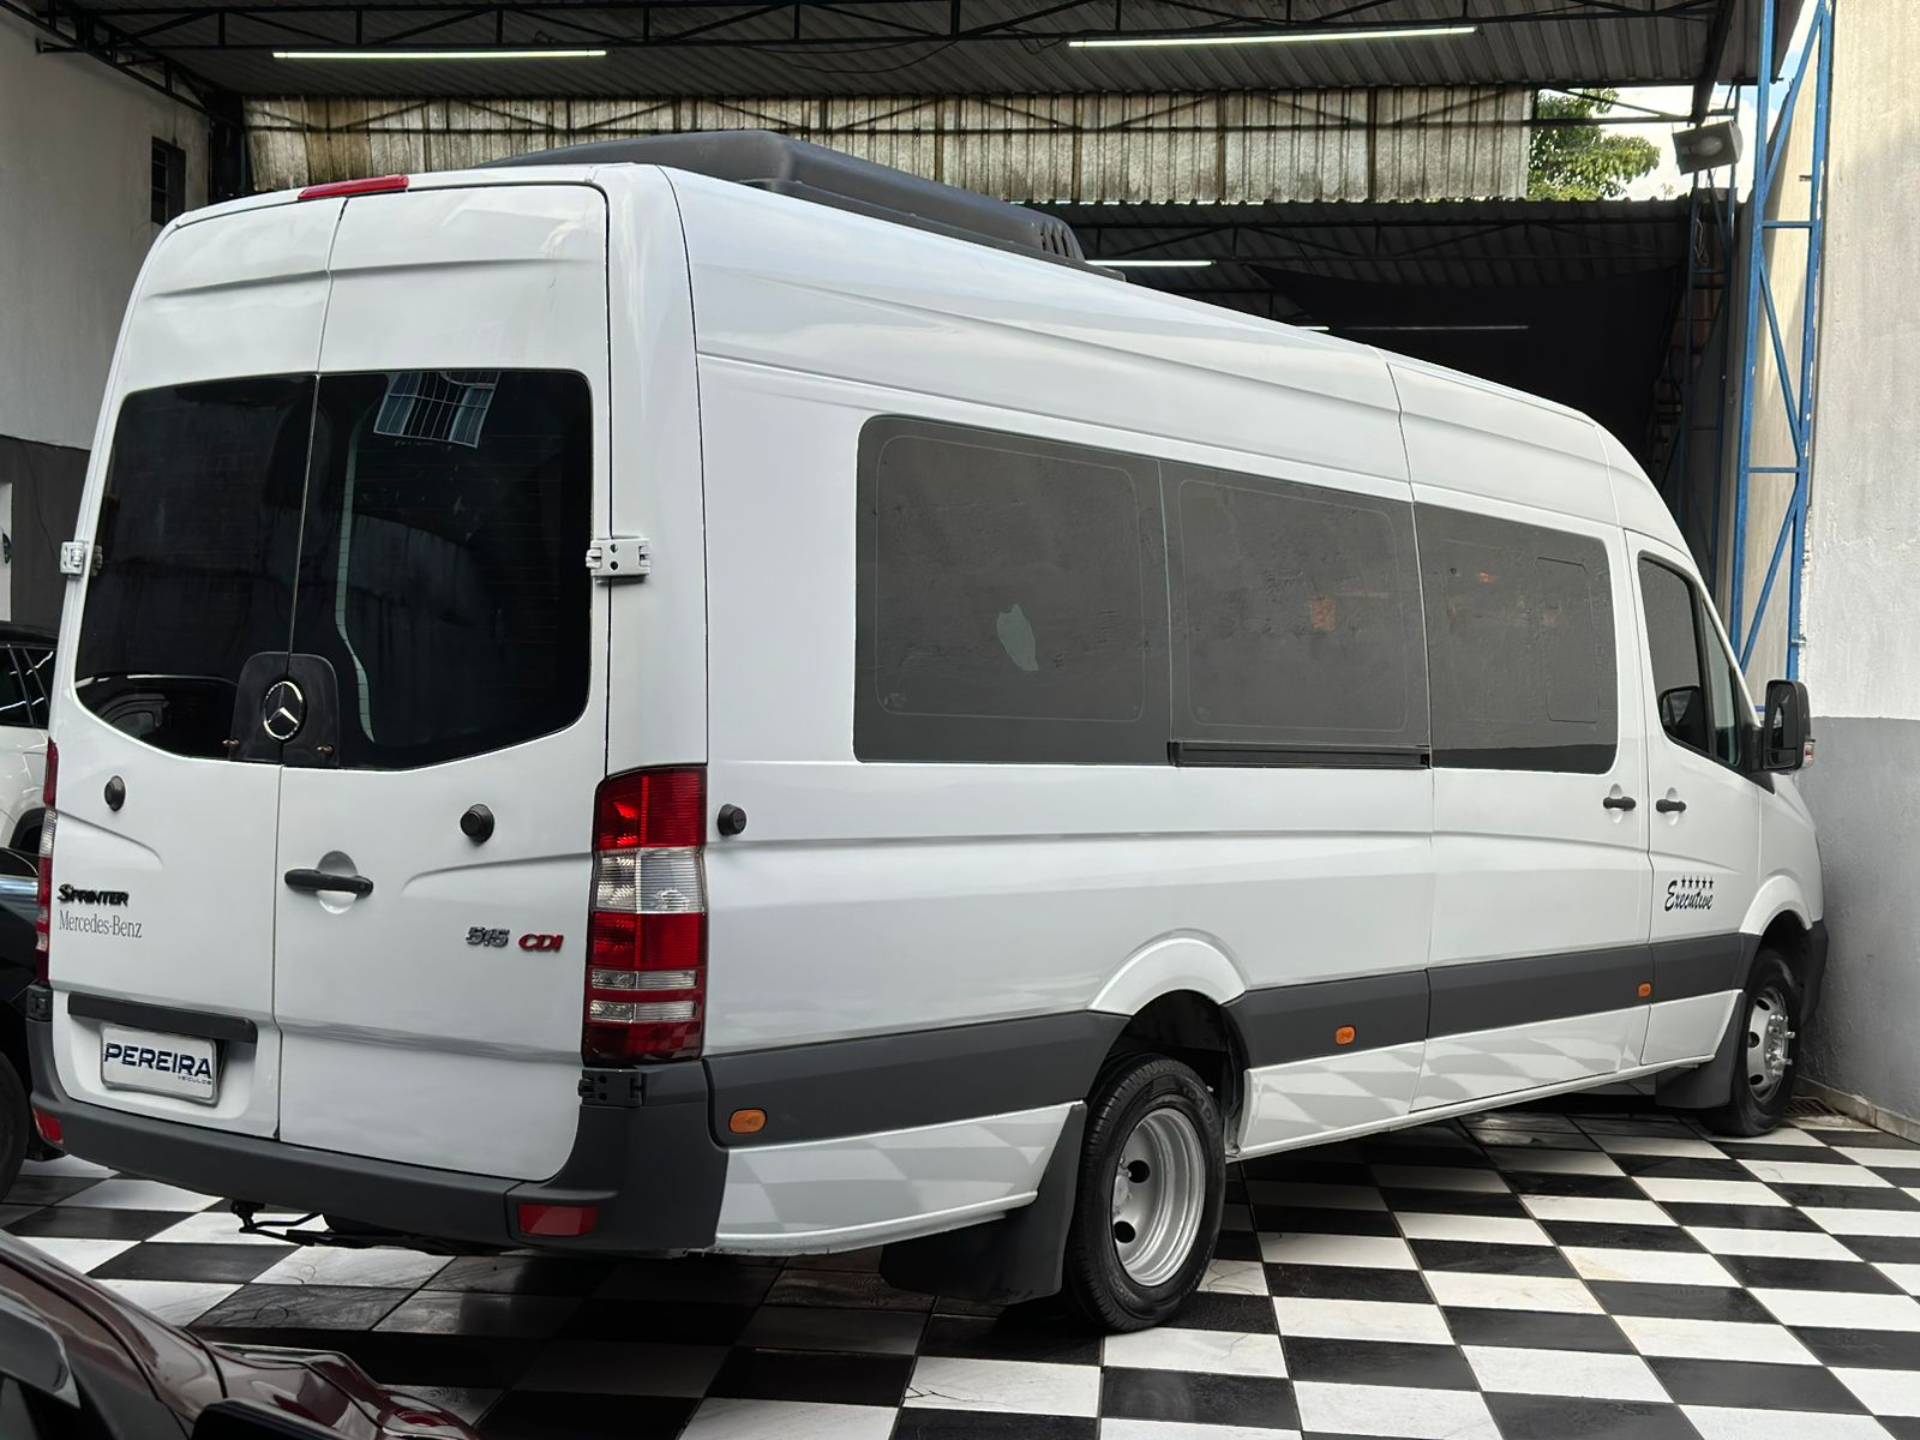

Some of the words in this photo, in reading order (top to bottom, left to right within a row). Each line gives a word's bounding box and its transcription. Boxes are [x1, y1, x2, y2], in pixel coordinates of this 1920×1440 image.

[1664, 880, 1714, 912] Executive
[58, 909, 143, 939] Mercedes-Benz
[465, 926, 511, 948] 515
[518, 933, 564, 952] CDI
[104, 1042, 212, 1079] PEREIRA
